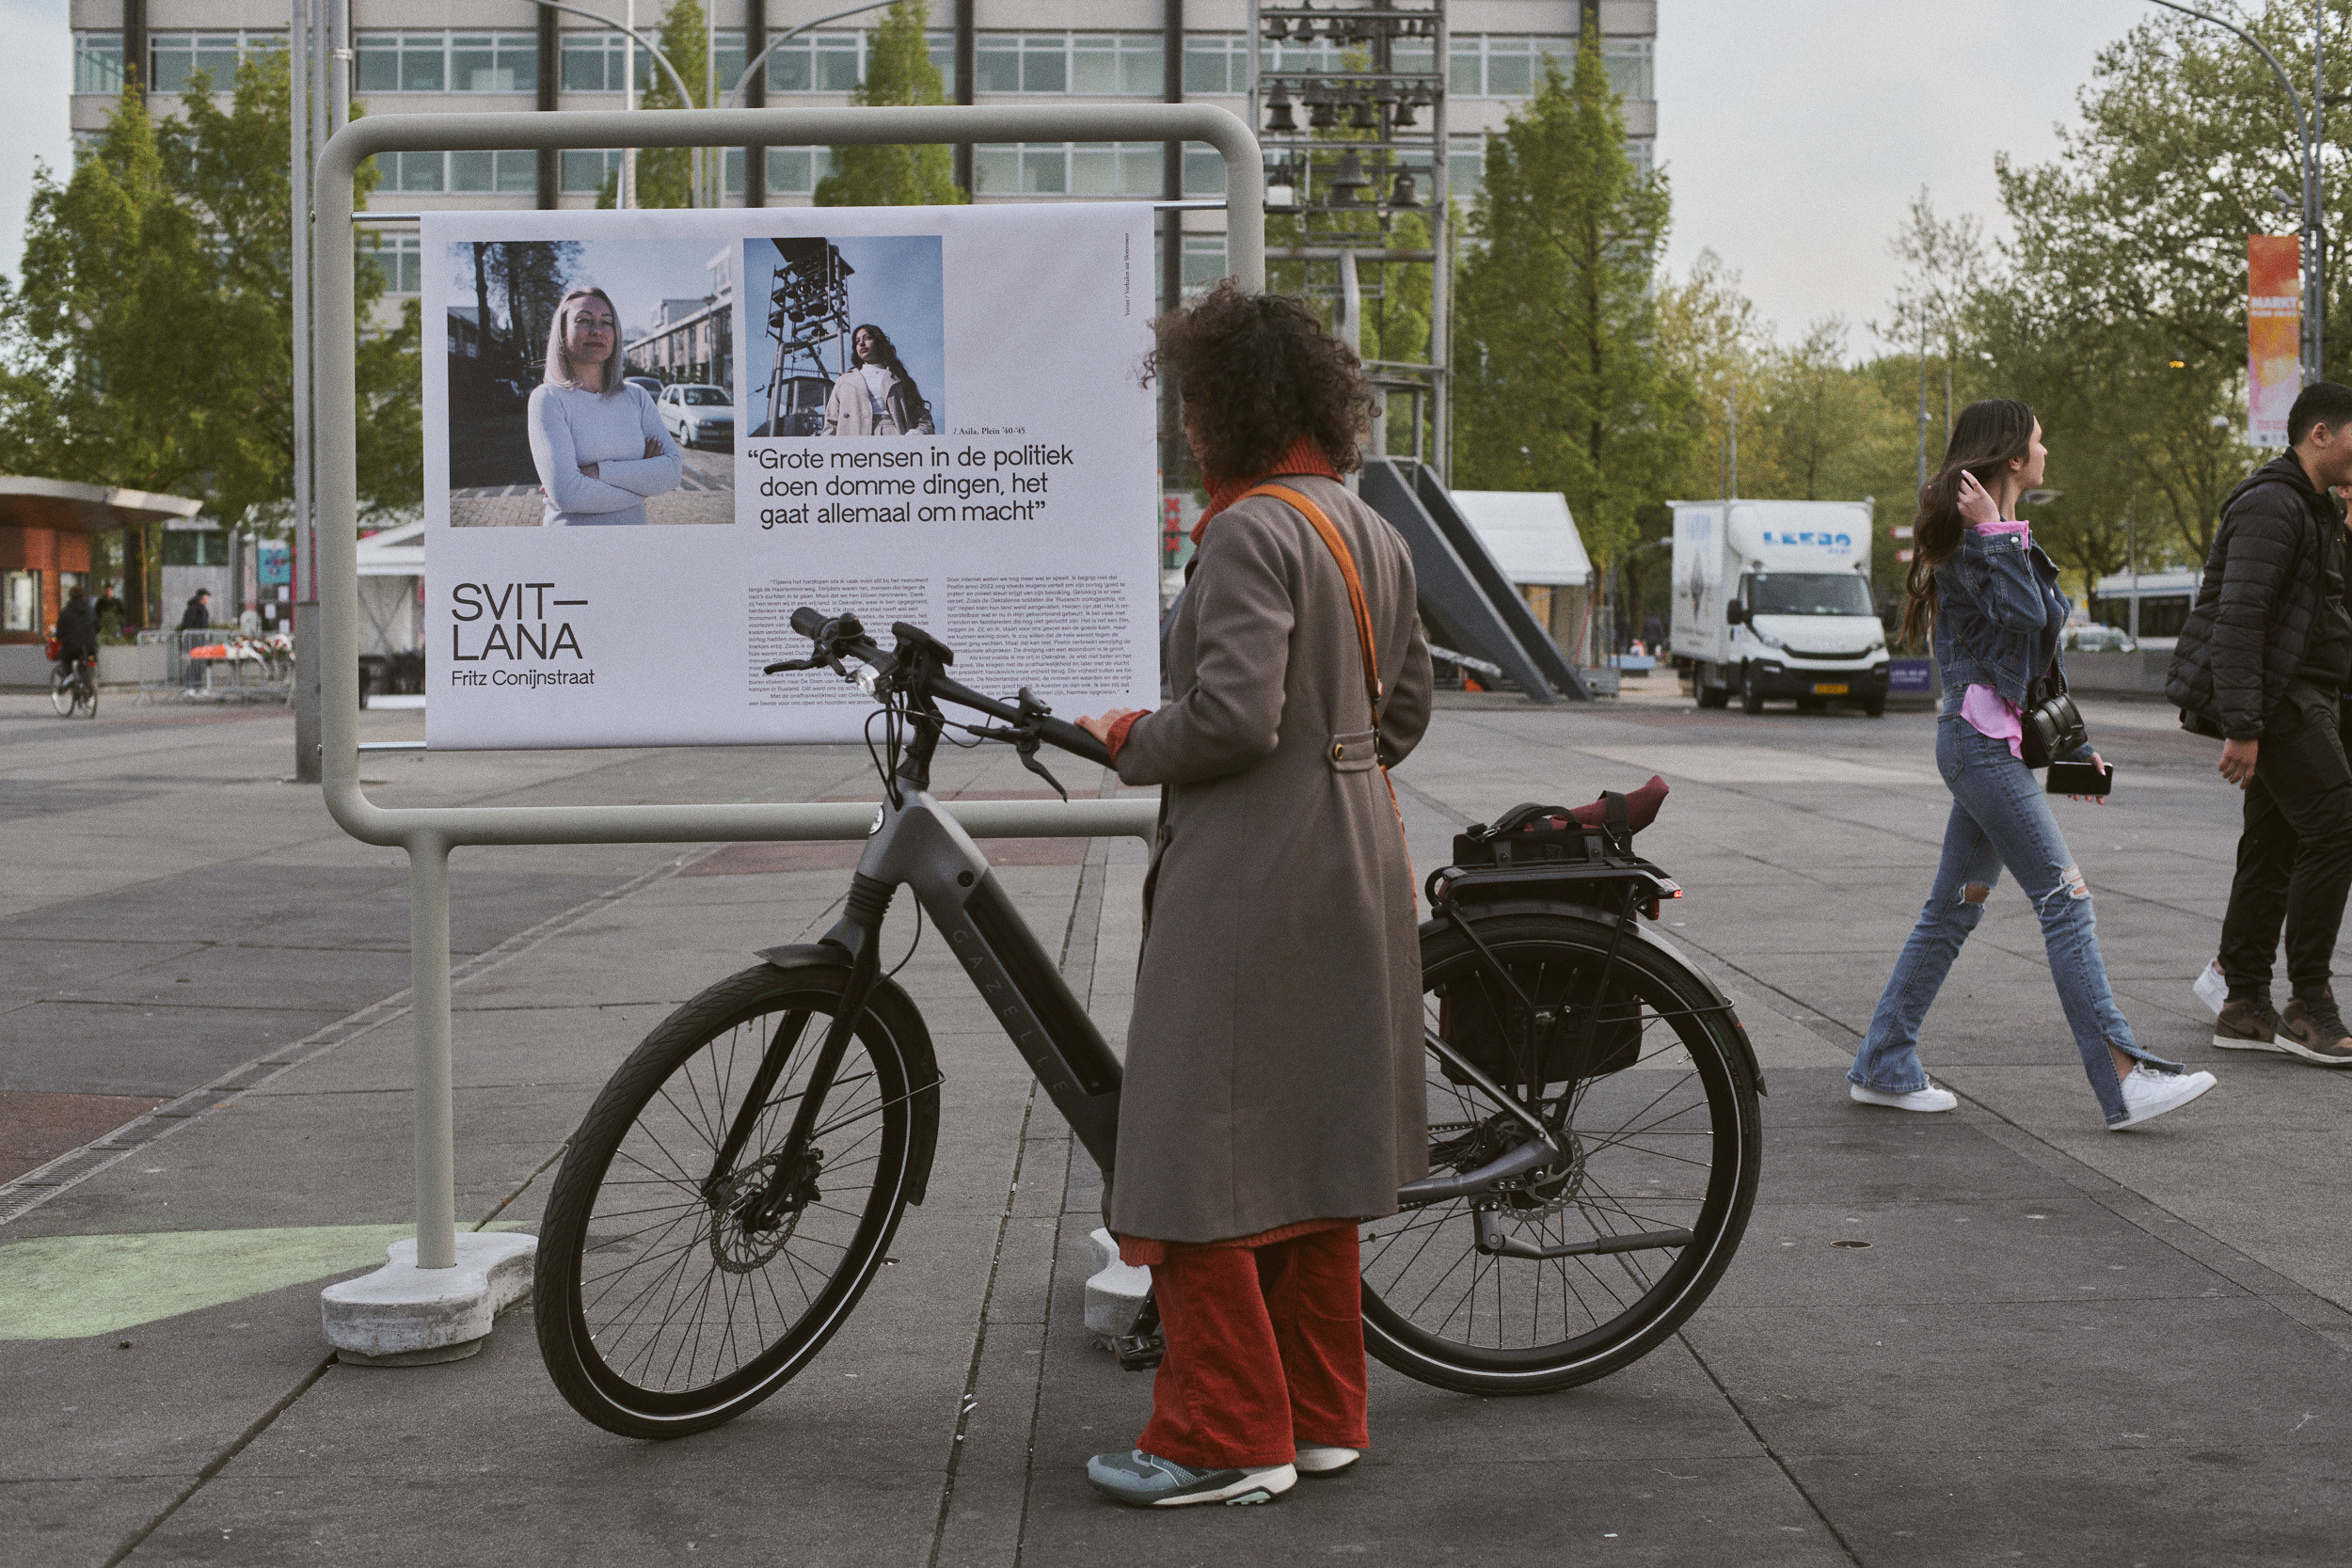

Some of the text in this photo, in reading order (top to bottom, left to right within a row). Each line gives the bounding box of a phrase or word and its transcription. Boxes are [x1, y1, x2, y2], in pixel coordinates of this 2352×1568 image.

[959, 427, 979, 436] Asila,
[832, 448, 922, 468] mensen
[931, 446, 949, 467] in
[958, 445, 985, 467] de
[994, 444, 1073, 471] politiek
[760, 472, 1049, 499] doen domme dingen, het
[760, 503, 809, 530] gaat
[817, 502, 911, 524] allemaal
[918, 505, 956, 522] om
[453, 623, 583, 661] LANA
[452, 669, 596, 689] Fritz Conijnstraat
[952, 929, 1069, 1093] GAZELLE
